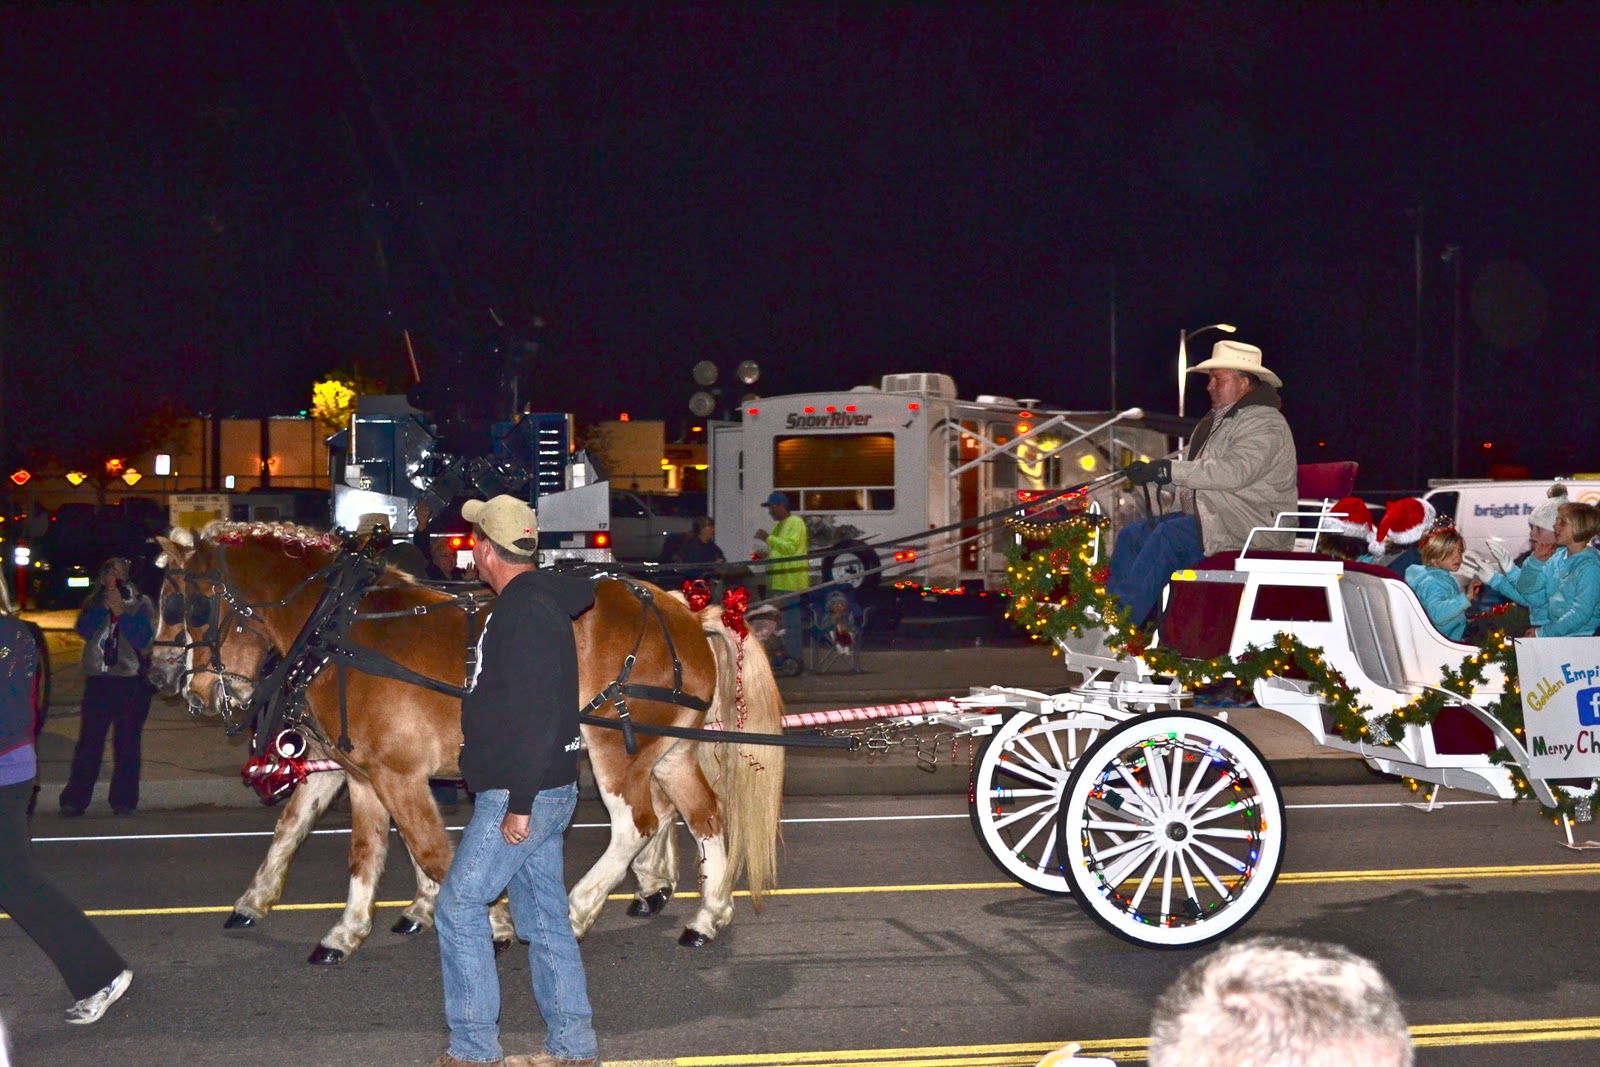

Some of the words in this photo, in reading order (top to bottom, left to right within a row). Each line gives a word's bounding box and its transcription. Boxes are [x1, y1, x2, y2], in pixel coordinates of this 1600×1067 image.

[1474, 503, 1520, 519] bright
[1523, 503, 1534, 516] h
[1526, 676, 1565, 712] Golden
[1532, 735, 1574, 761] Merry
[1576, 730, 1600, 754] Ch
